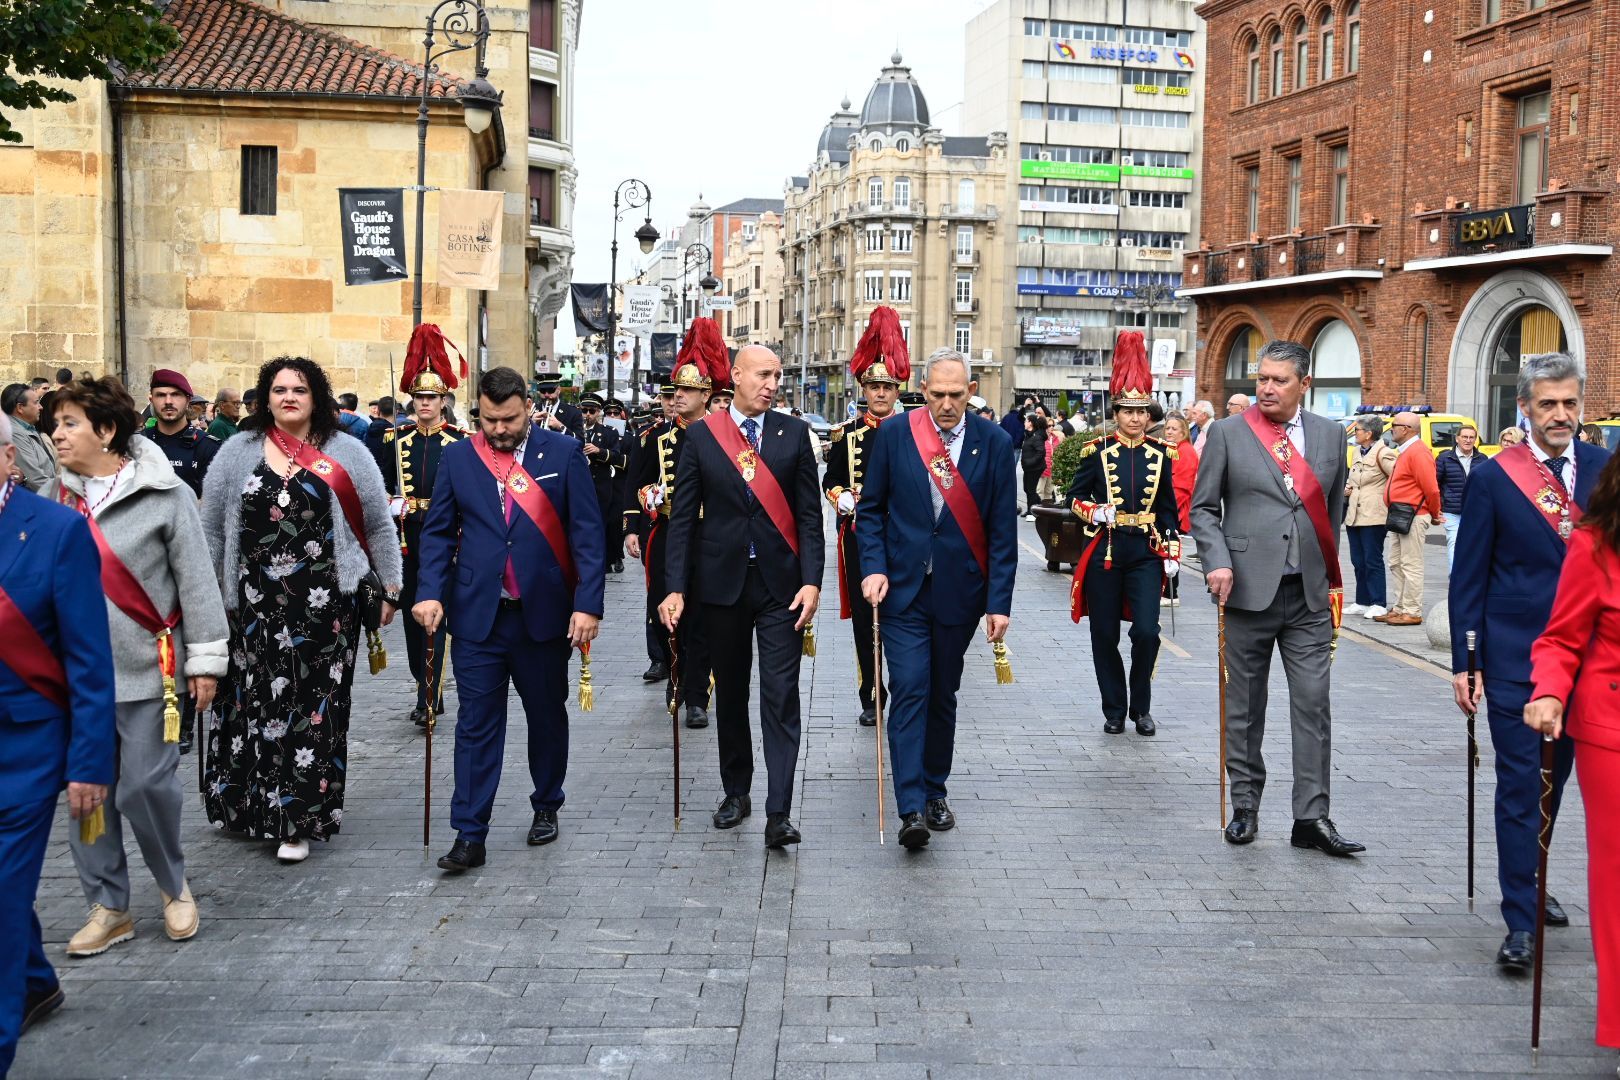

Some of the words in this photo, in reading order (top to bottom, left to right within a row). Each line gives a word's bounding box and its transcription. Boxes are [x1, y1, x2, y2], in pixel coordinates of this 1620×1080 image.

[1091, 47, 1158, 63] INSEFOR
[1135, 85, 1159, 93] OXFORD
[1165, 87, 1189, 95] IDIOMAS
[1033, 166, 1110, 176] MATRIMONIALISTA
[353, 223, 391, 234] House
[1461, 212, 1514, 241] BBVA
[356, 234, 369, 245] of
[370, 234, 390, 245] the
[448, 233, 474, 243] CASA
[353, 245, 396, 258] Dragon
[447, 243, 493, 253] BOTINES
